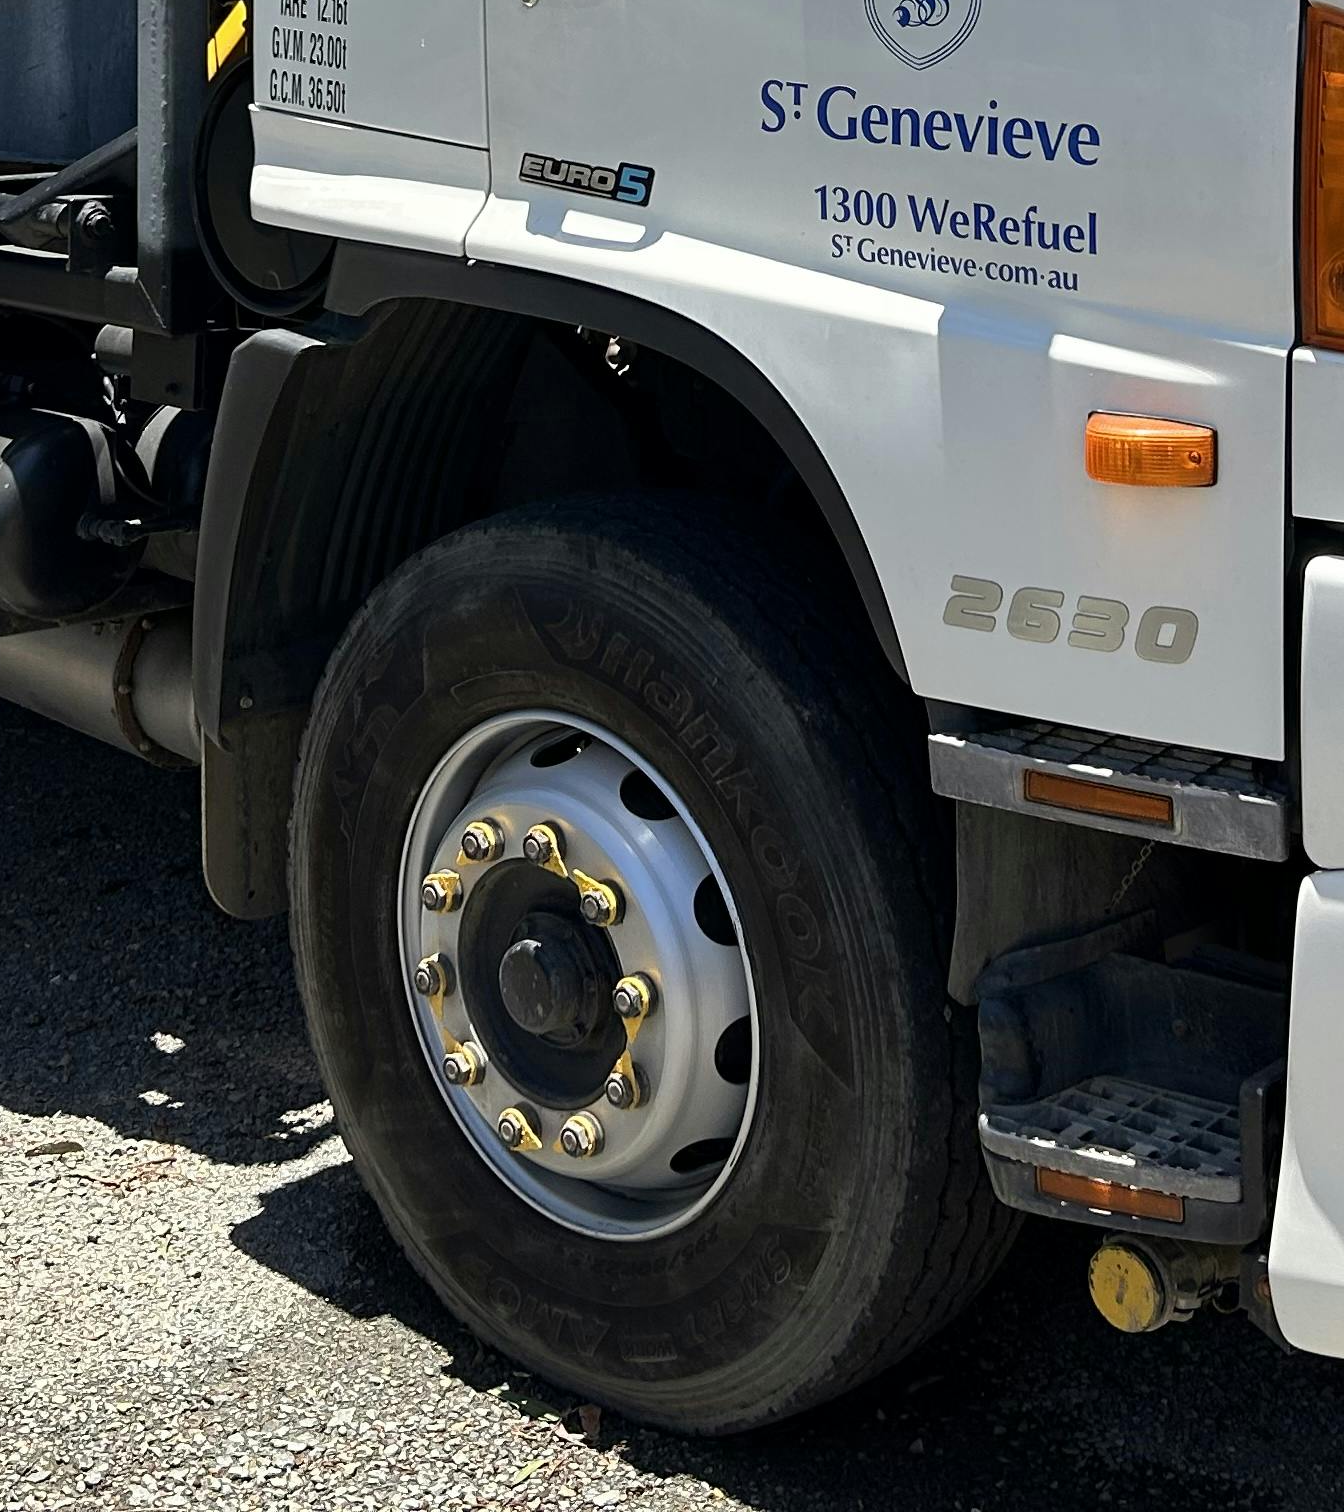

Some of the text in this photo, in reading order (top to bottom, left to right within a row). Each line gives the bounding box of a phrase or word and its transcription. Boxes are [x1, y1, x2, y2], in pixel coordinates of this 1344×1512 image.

[272, 26, 347, 70] G.V.M. 23.00t
[269, 68, 346, 114] G.C.M. 36.50t
[816, 84, 1100, 166] Genevieve
[814, 184, 1098, 255] 1300 WeRefuel
[943, 574, 1199, 664] 2630
